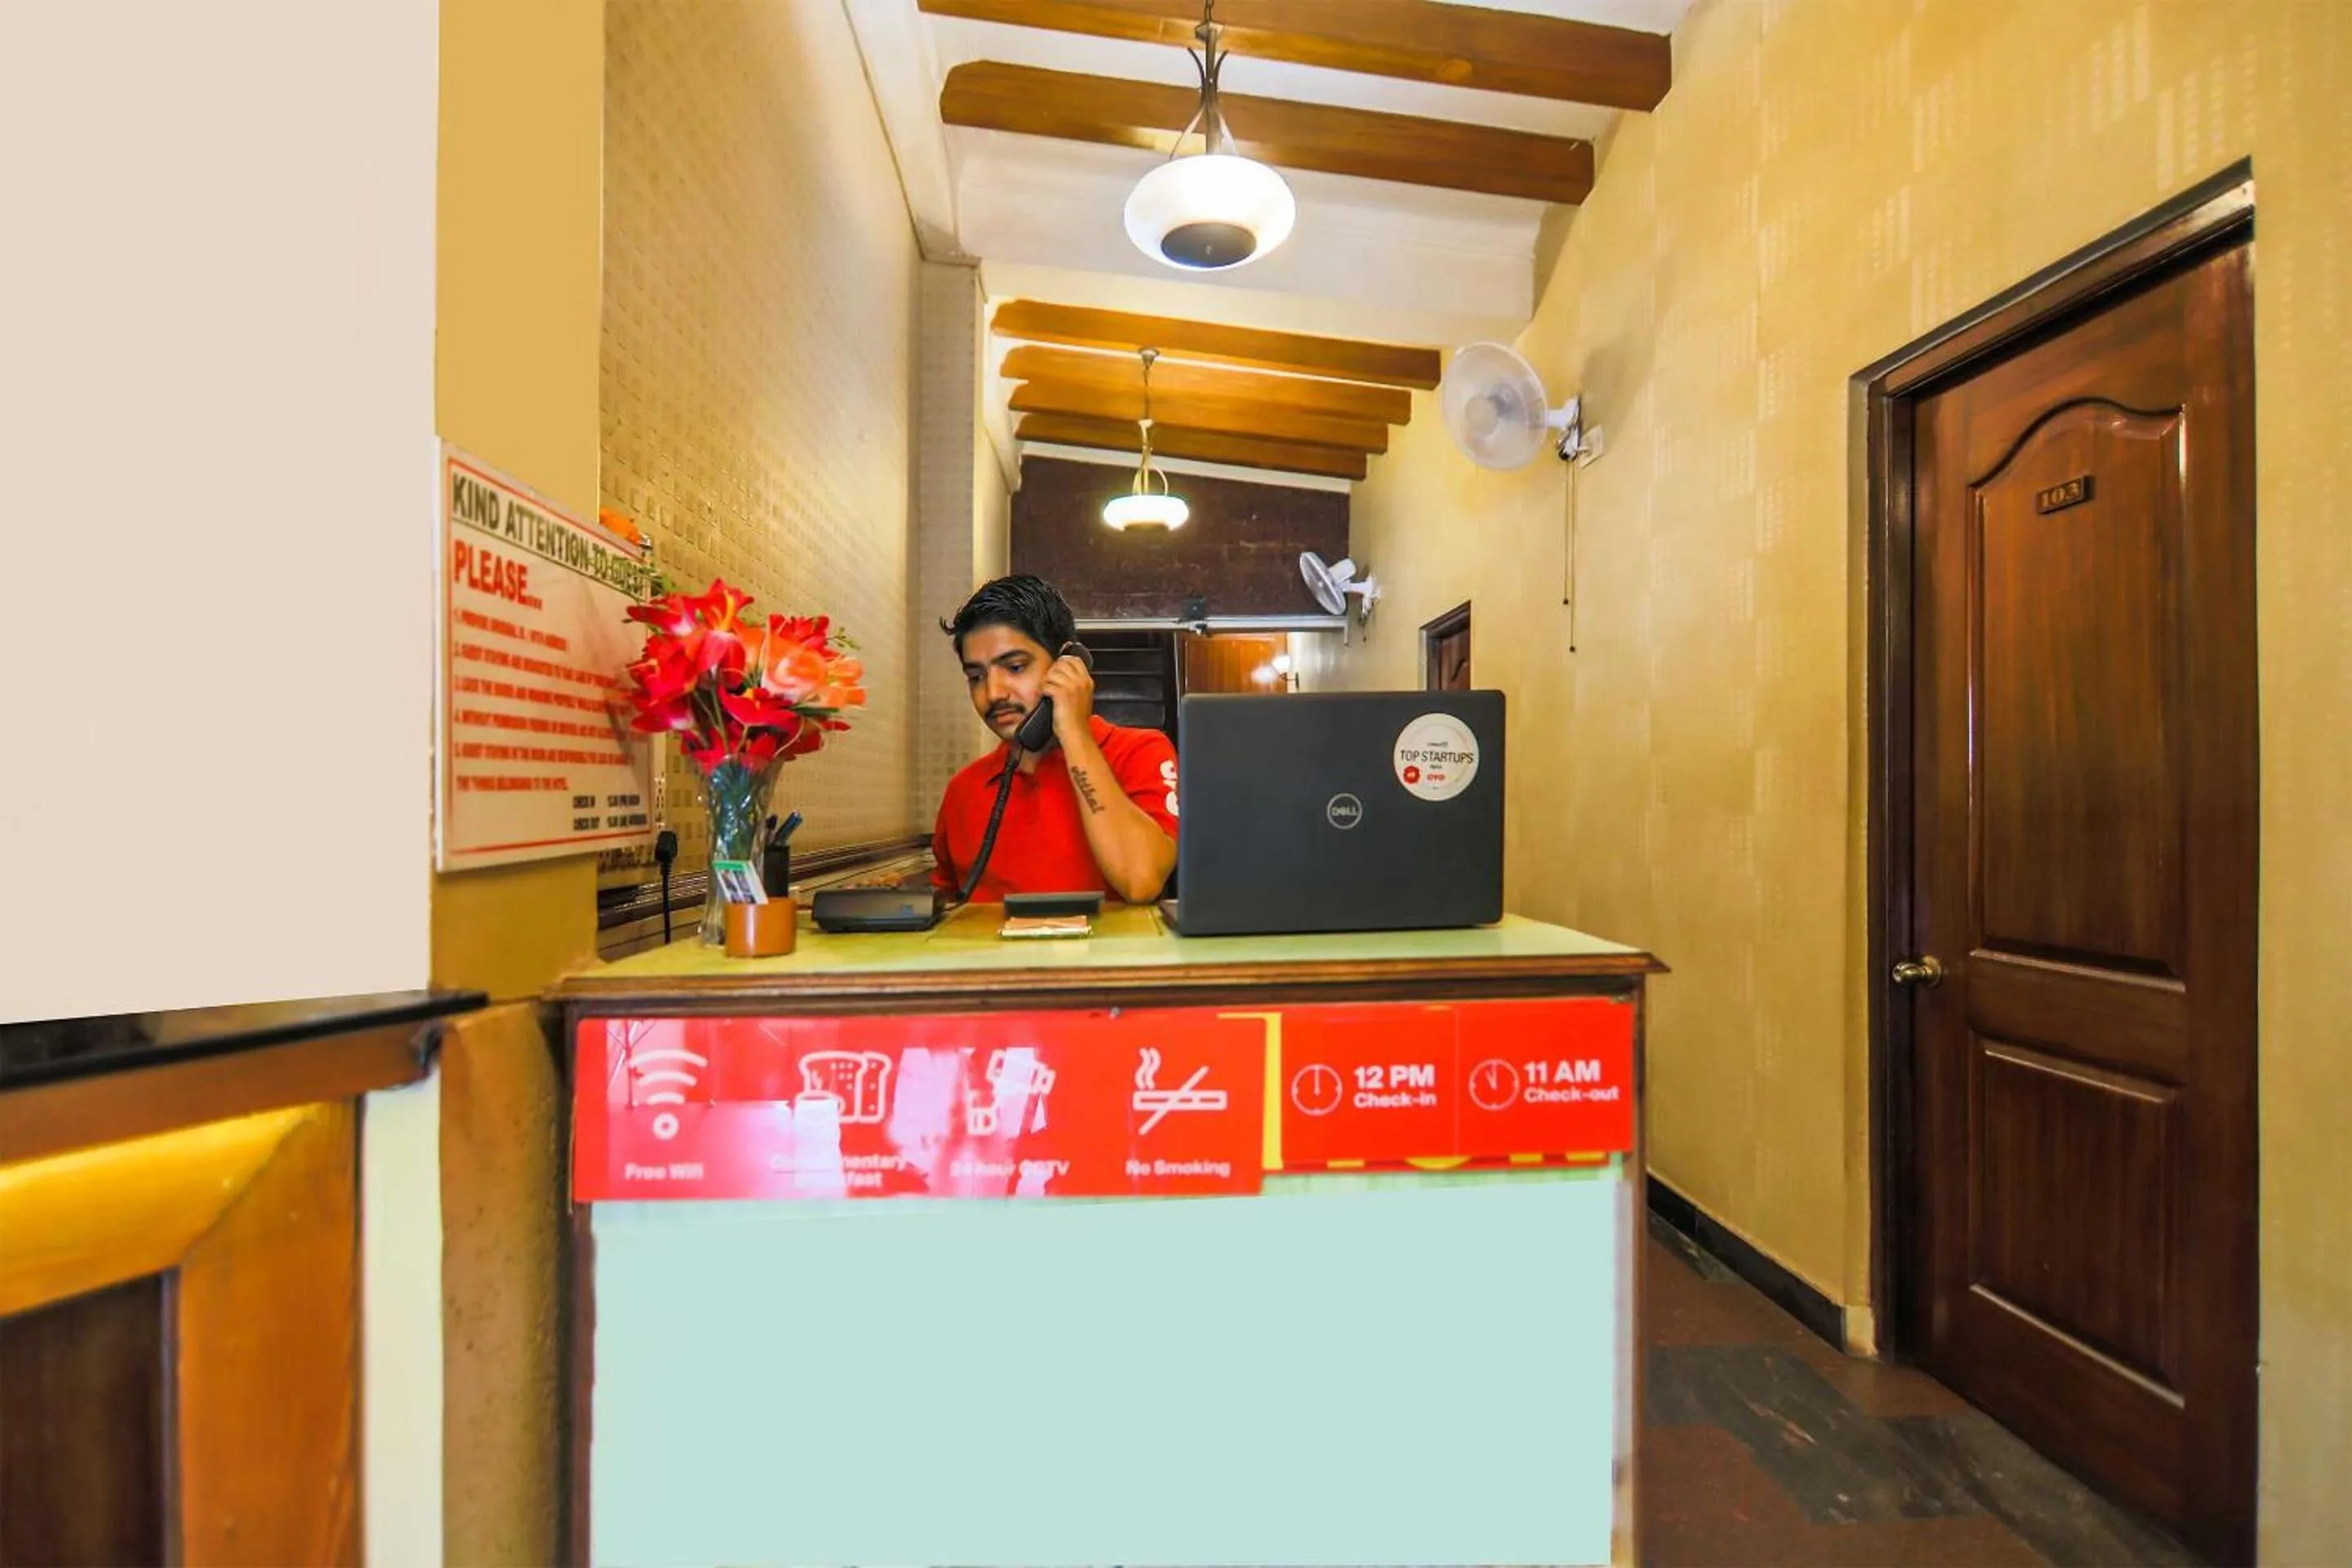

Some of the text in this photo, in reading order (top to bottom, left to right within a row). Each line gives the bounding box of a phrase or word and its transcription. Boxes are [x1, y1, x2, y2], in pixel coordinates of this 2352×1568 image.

[2041, 482, 2080, 509] 103
[452, 471, 501, 532] KIND
[505, 499, 590, 572] ATTENTION
[1401, 750, 1474, 764] TOP STARTUPS
[1330, 805, 1359, 817] DELL
[1353, 1063, 1436, 1089] 12 PM
[1524, 1058, 1601, 1085] 11 AM
[1353, 1091, 1437, 1109] Check-in
[1524, 1085, 1619, 1104] Check-out
[624, 1161, 667, 1181] Free
[1125, 1159, 1232, 1178] No Smoking
